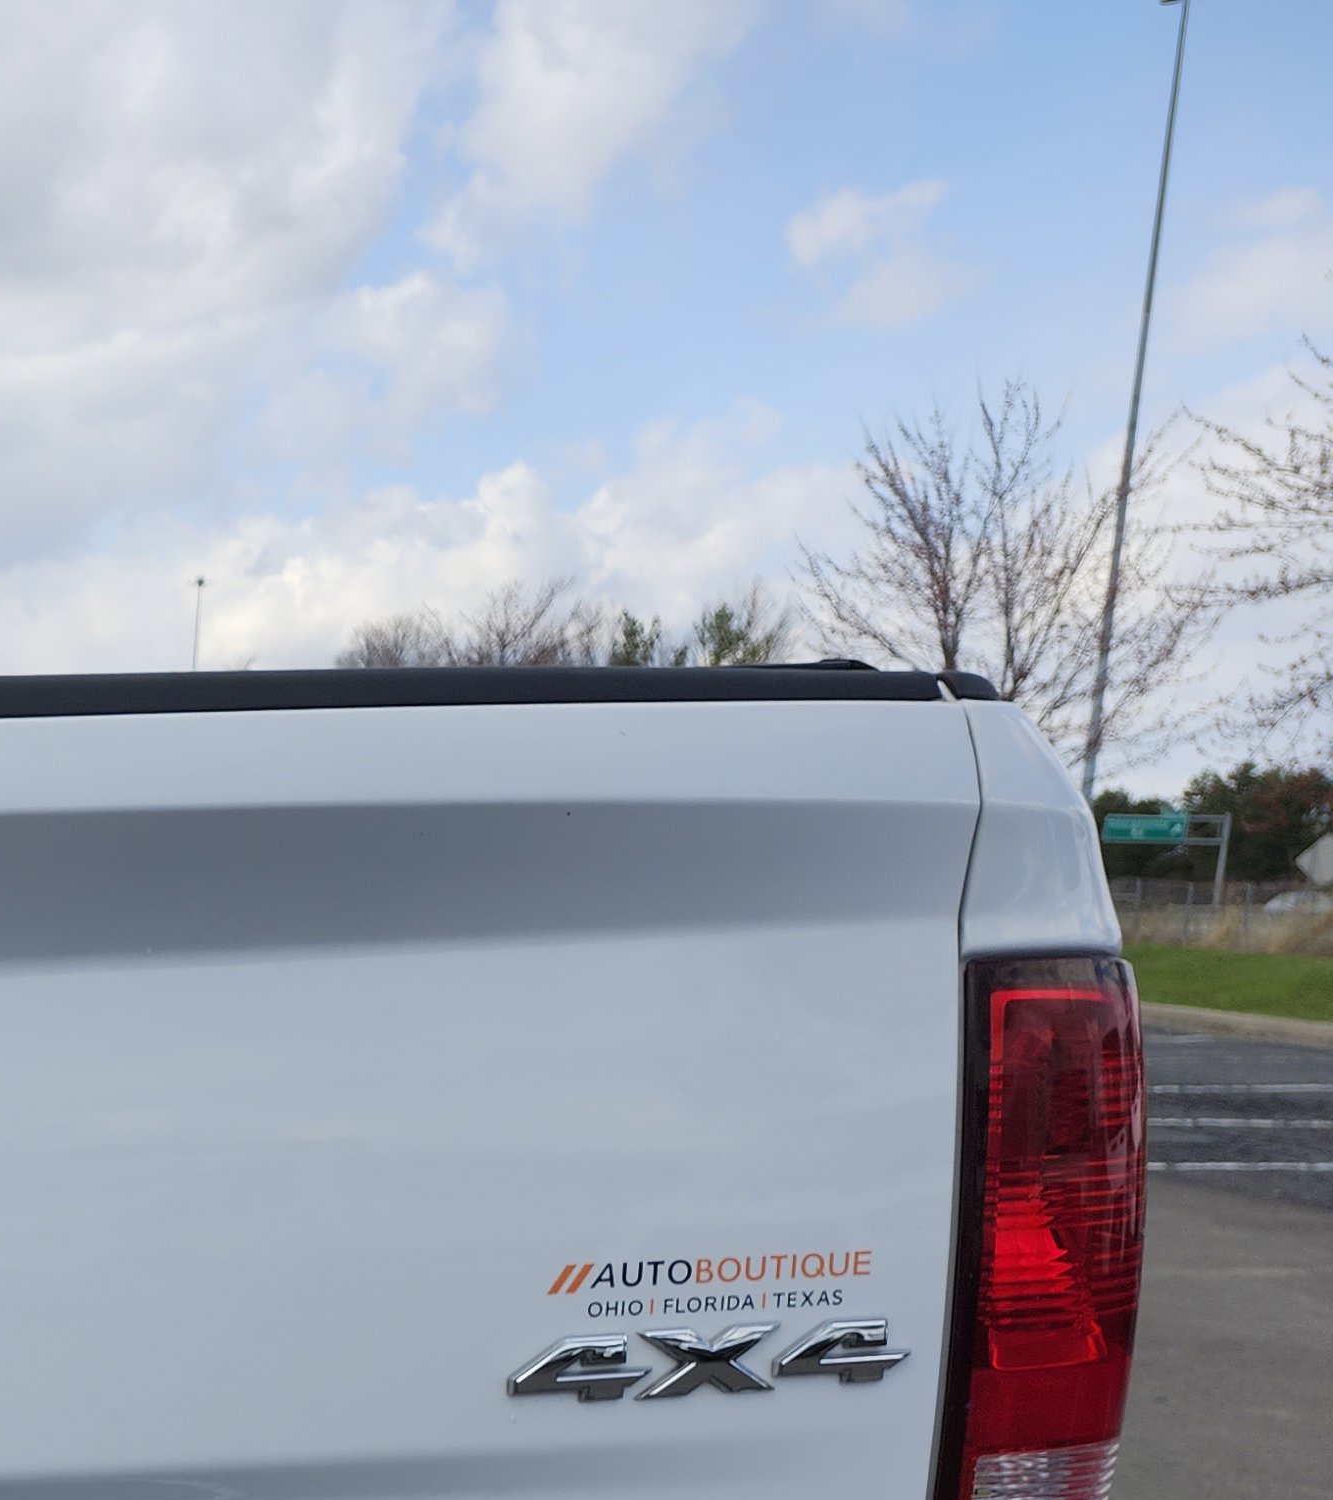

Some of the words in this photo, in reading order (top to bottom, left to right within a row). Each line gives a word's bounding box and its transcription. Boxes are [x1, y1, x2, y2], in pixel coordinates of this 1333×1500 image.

[589, 1250, 872, 1290] AUTOBOUTIQUE
[587, 1300, 644, 1318] OHIO
[663, 1294, 755, 1314] FLORIDA
[773, 1289, 844, 1309] TEXAS
[506, 1316, 912, 1403] 4X4
